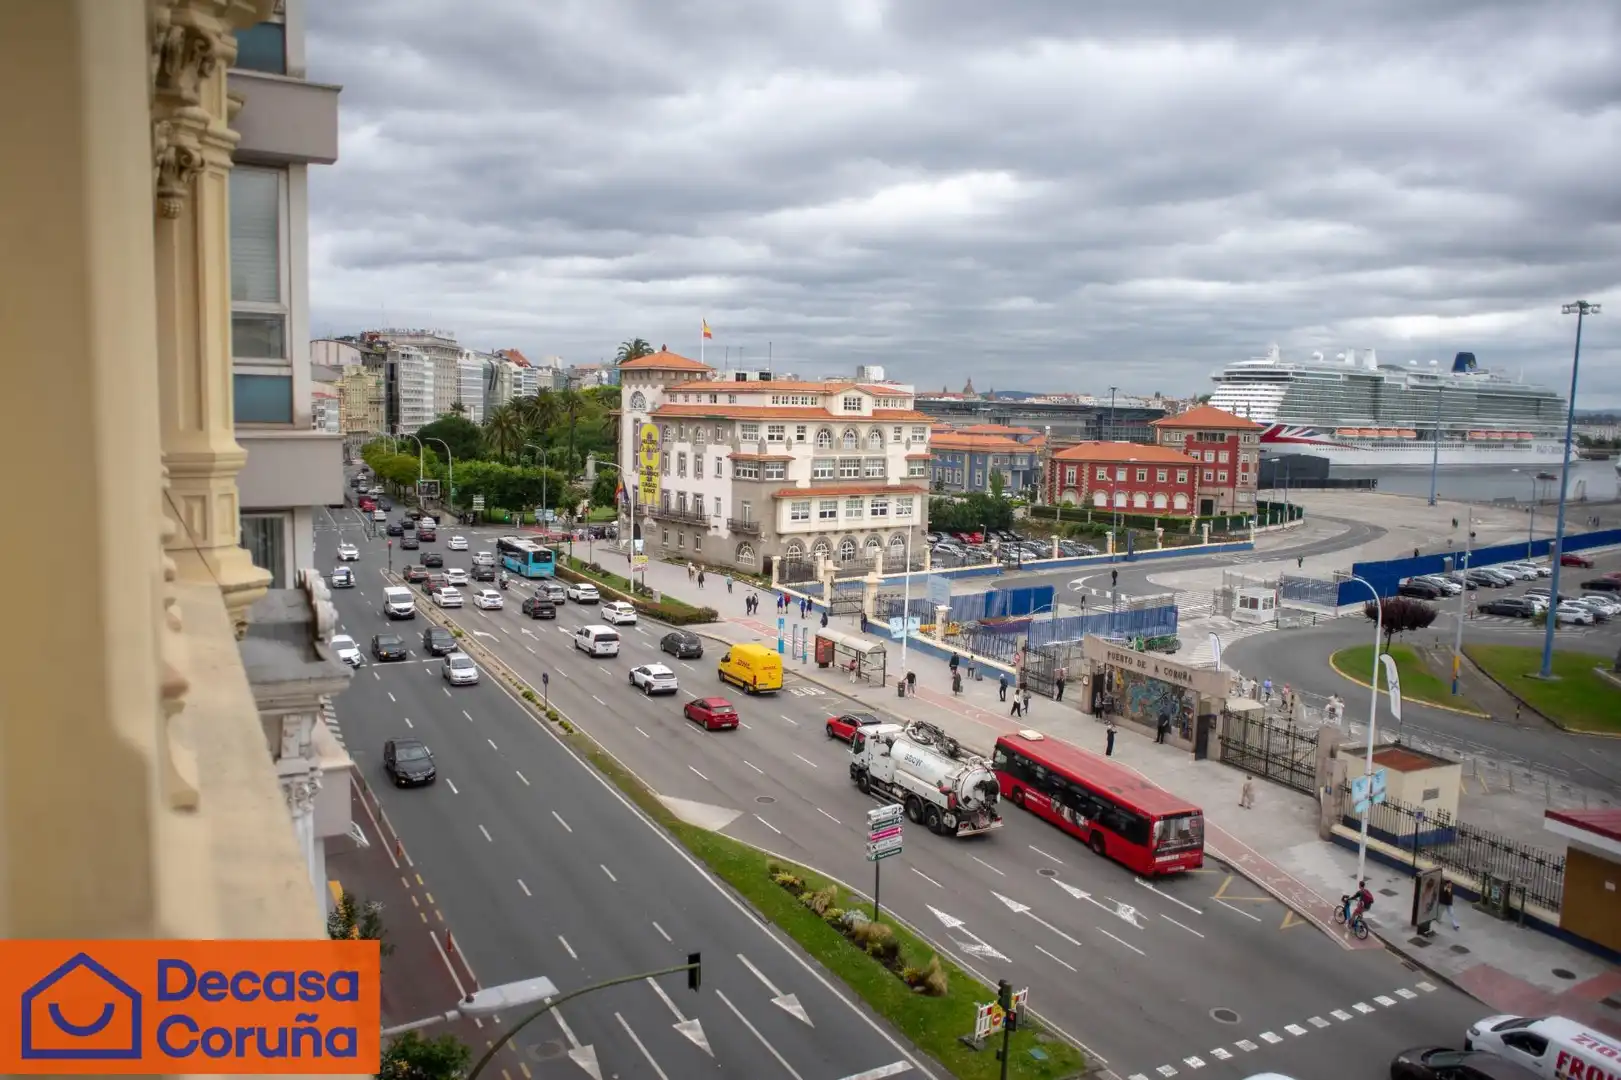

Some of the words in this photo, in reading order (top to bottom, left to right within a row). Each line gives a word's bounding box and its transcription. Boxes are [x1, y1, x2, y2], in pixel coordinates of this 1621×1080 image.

[1107, 650, 1133, 665] PUERTO
[1137, 659, 1147, 669] DE
[1163, 667, 1193, 682] CORUÑA
